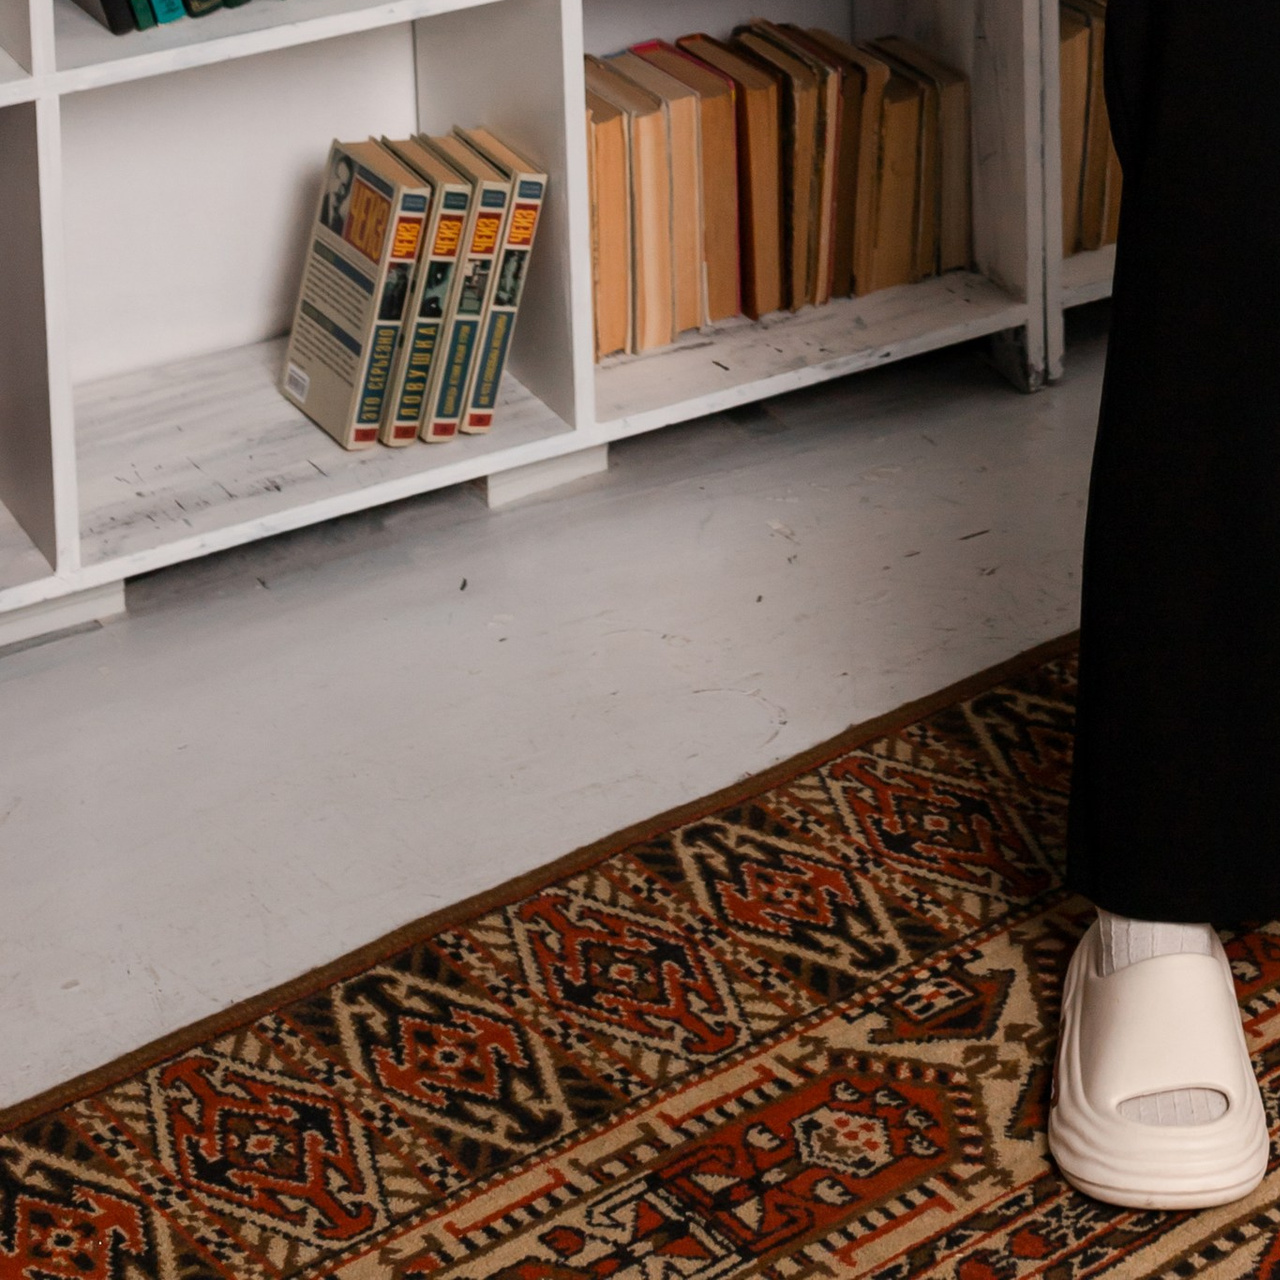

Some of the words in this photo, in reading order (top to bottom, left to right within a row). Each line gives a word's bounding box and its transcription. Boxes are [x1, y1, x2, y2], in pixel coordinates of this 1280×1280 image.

[365, 325, 397, 392] СЕРЬЕЗНО
[395, 322, 441, 419] ЛОВУШКА
[359, 393, 382, 422] ЭТО
